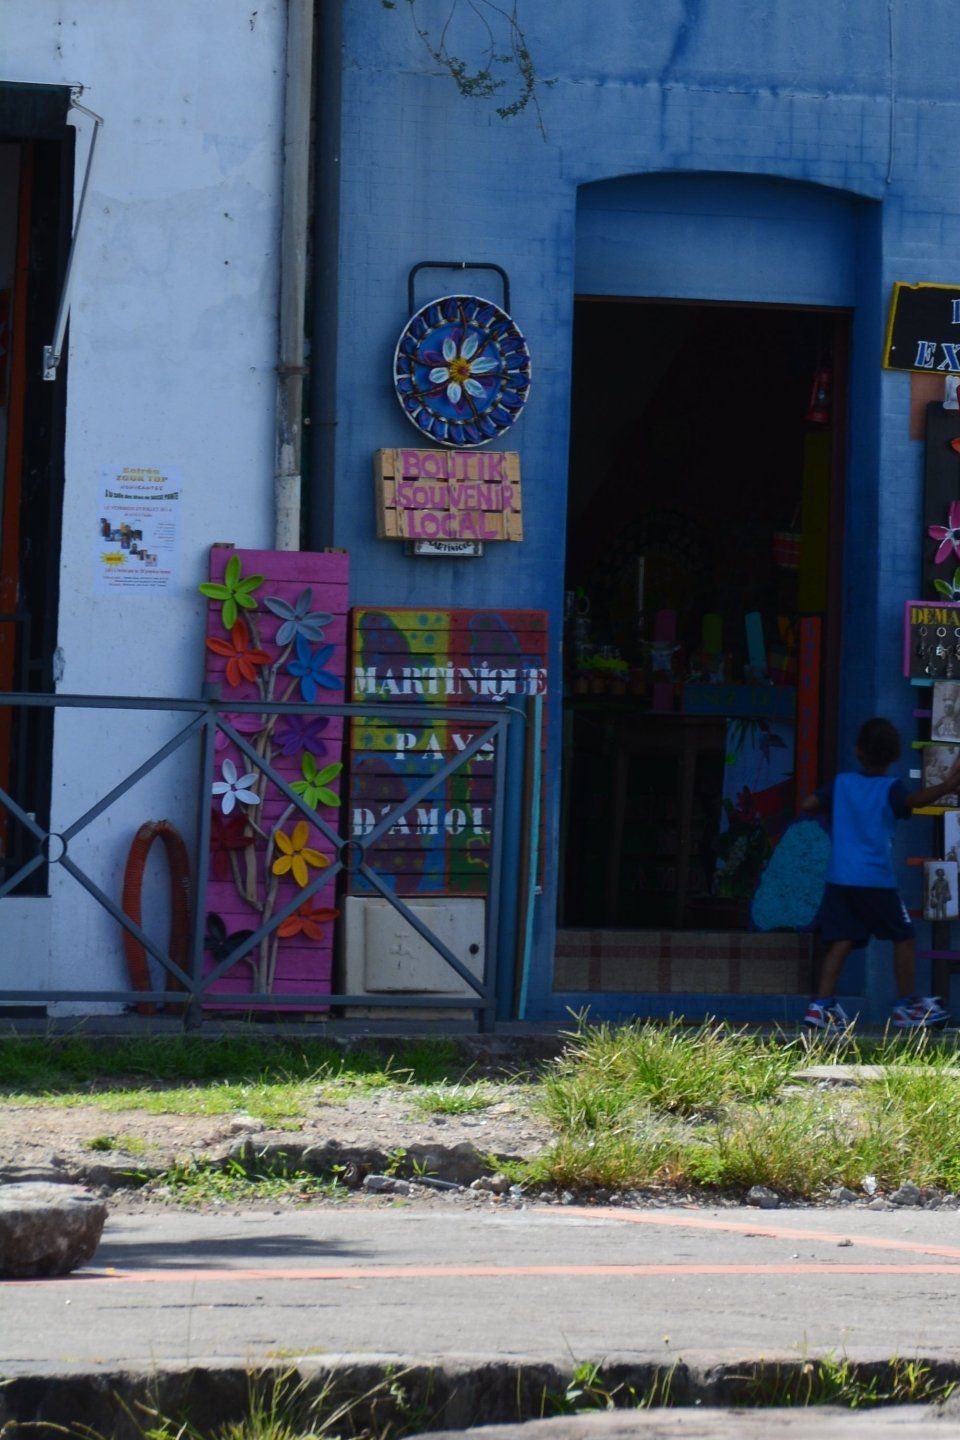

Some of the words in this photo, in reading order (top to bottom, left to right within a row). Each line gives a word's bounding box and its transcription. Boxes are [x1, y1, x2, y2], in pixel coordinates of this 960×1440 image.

[401, 450, 507, 479] BOUTIK
[392, 481, 515, 511] SOUVENIR
[406, 510, 499, 540] LOCAL
[394, 732, 497, 761] PAYS
[352, 803, 492, 835] D'AMOU
